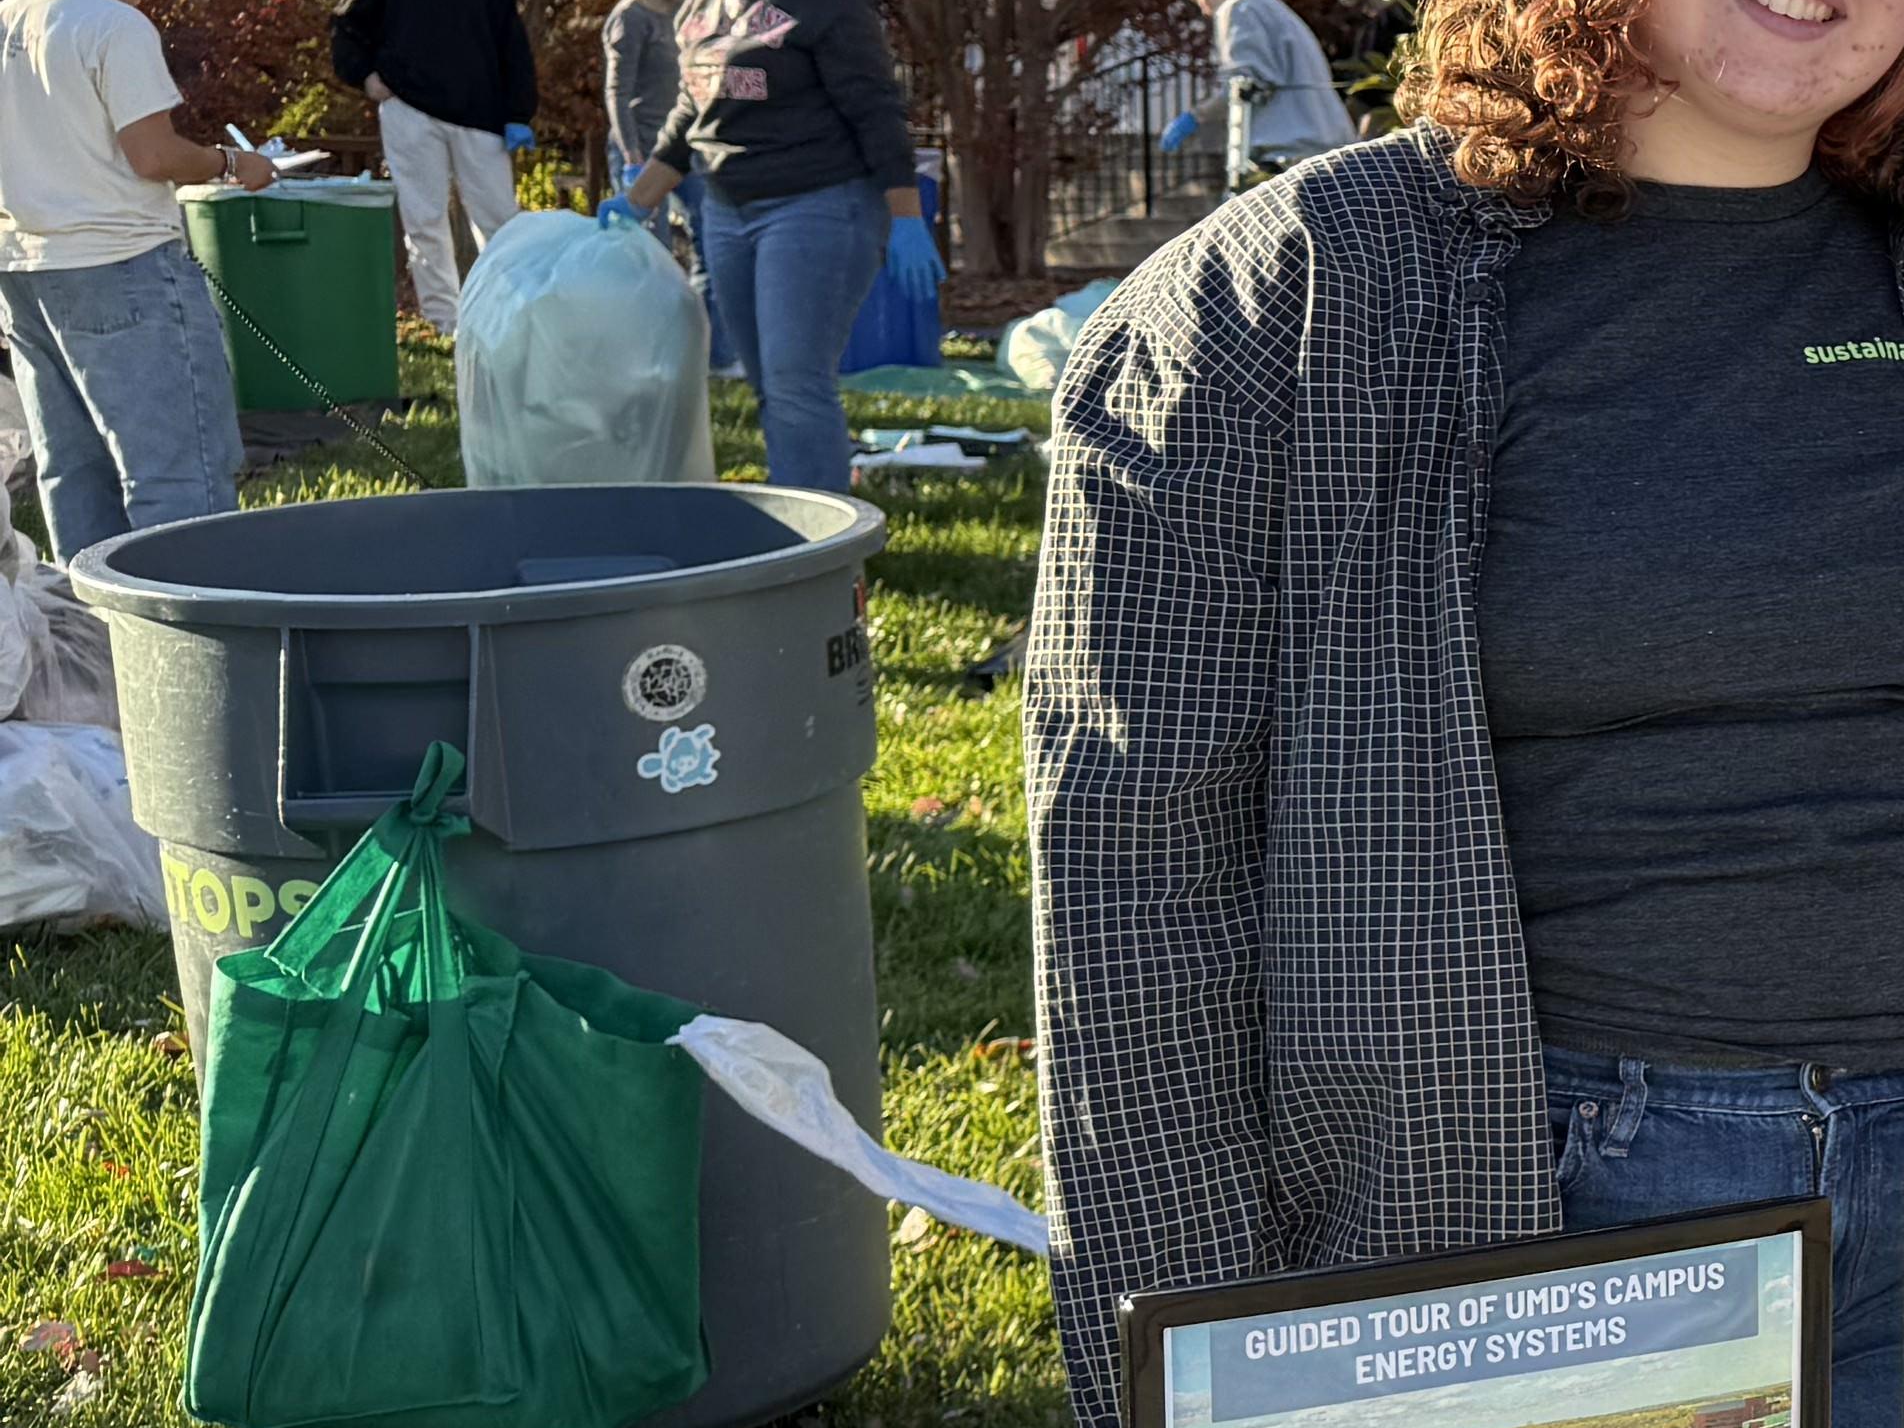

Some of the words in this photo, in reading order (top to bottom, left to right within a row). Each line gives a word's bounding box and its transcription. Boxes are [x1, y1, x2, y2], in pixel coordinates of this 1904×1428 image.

[1246, 1316, 1360, 1359] GUIDED
[1369, 1303, 1449, 1341] TOUR
[1460, 1295, 1497, 1327] OF
[1506, 1281, 1595, 1320] UMD'S
[1604, 1262, 1724, 1306] CAMPUS
[1356, 1338, 1478, 1385] ENERGY
[1486, 1316, 1626, 1362] SYSTEMS
